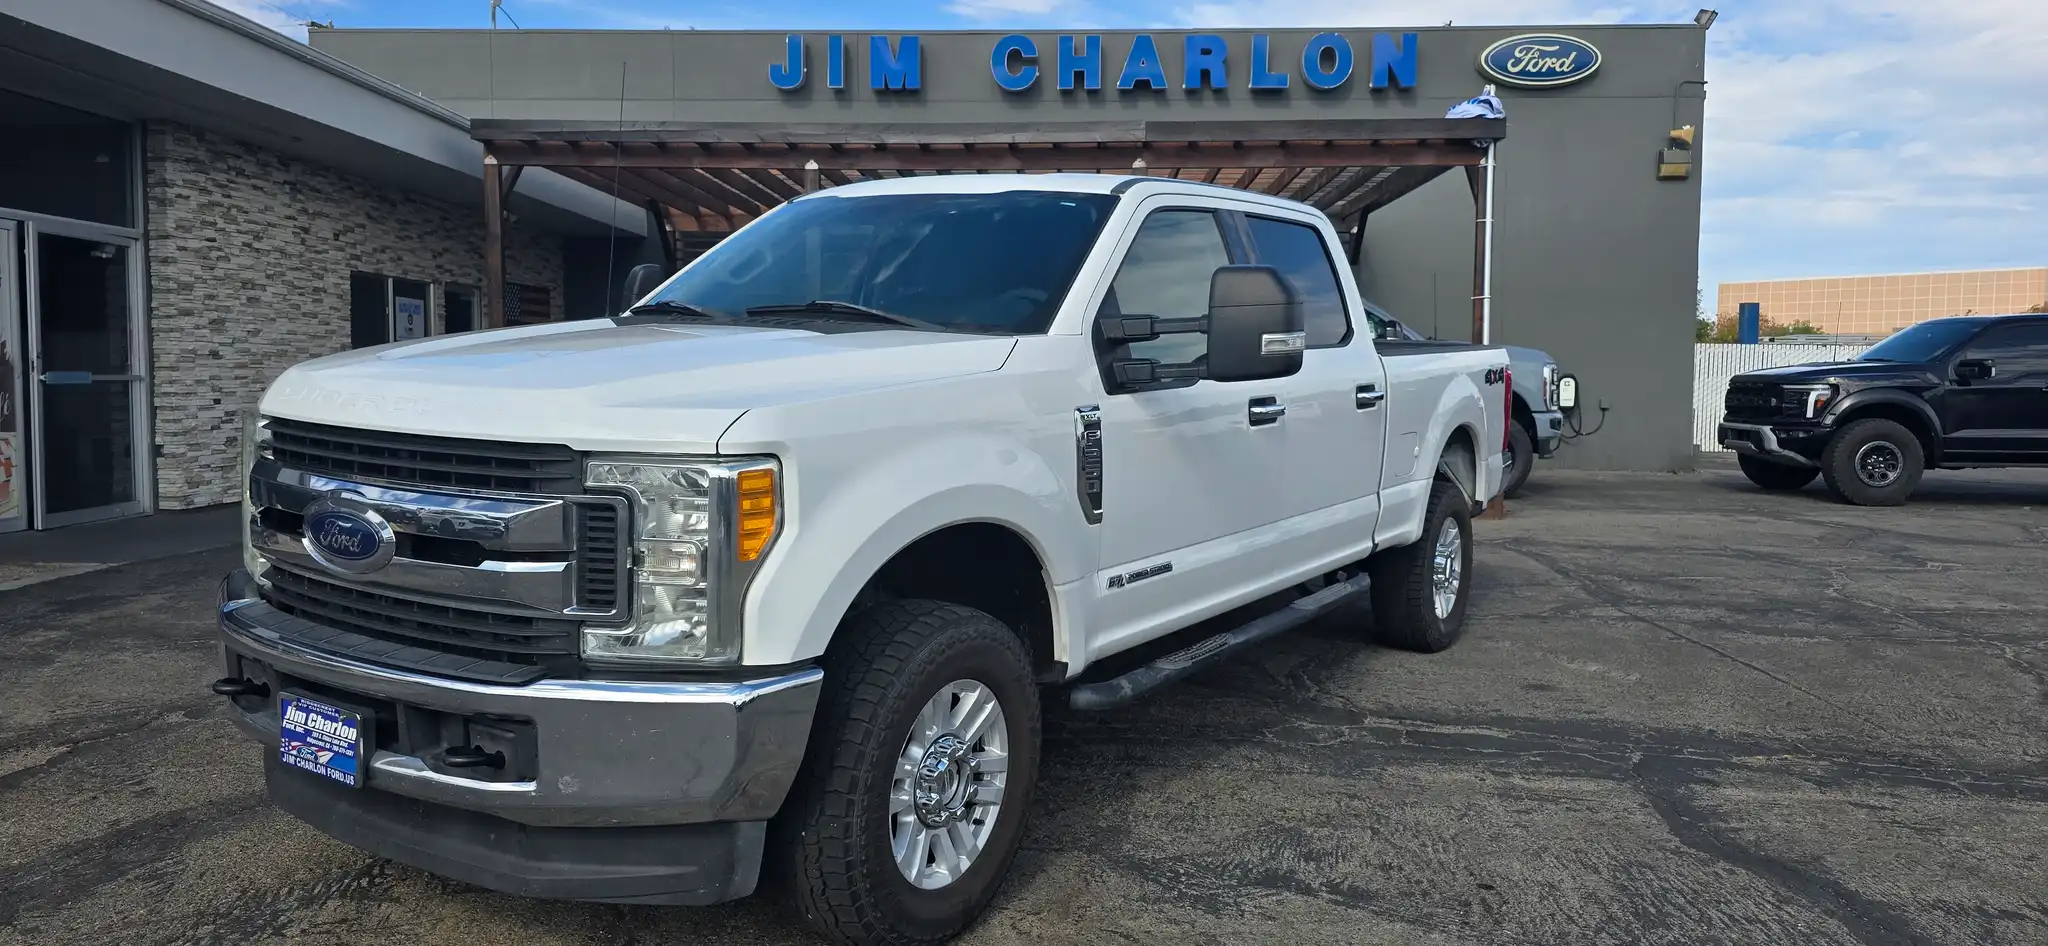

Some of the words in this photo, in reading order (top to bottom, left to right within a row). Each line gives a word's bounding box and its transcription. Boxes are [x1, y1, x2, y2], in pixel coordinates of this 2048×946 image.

[769, 34, 920, 90] JIM
[990, 32, 1418, 91] CHARLON
[1507, 44, 1577, 73] Ford
[1085, 412, 1098, 420] XLT
[320, 518, 363, 552] Ford
[284, 706, 307, 724] Jim
[307, 713, 357, 741] Charlon
[308, 704, 340, 717] CUSTOMER
[282, 753, 295, 765] JIM
[296, 757, 326, 776] CHARLON
[300, 747, 315, 760] Ford
